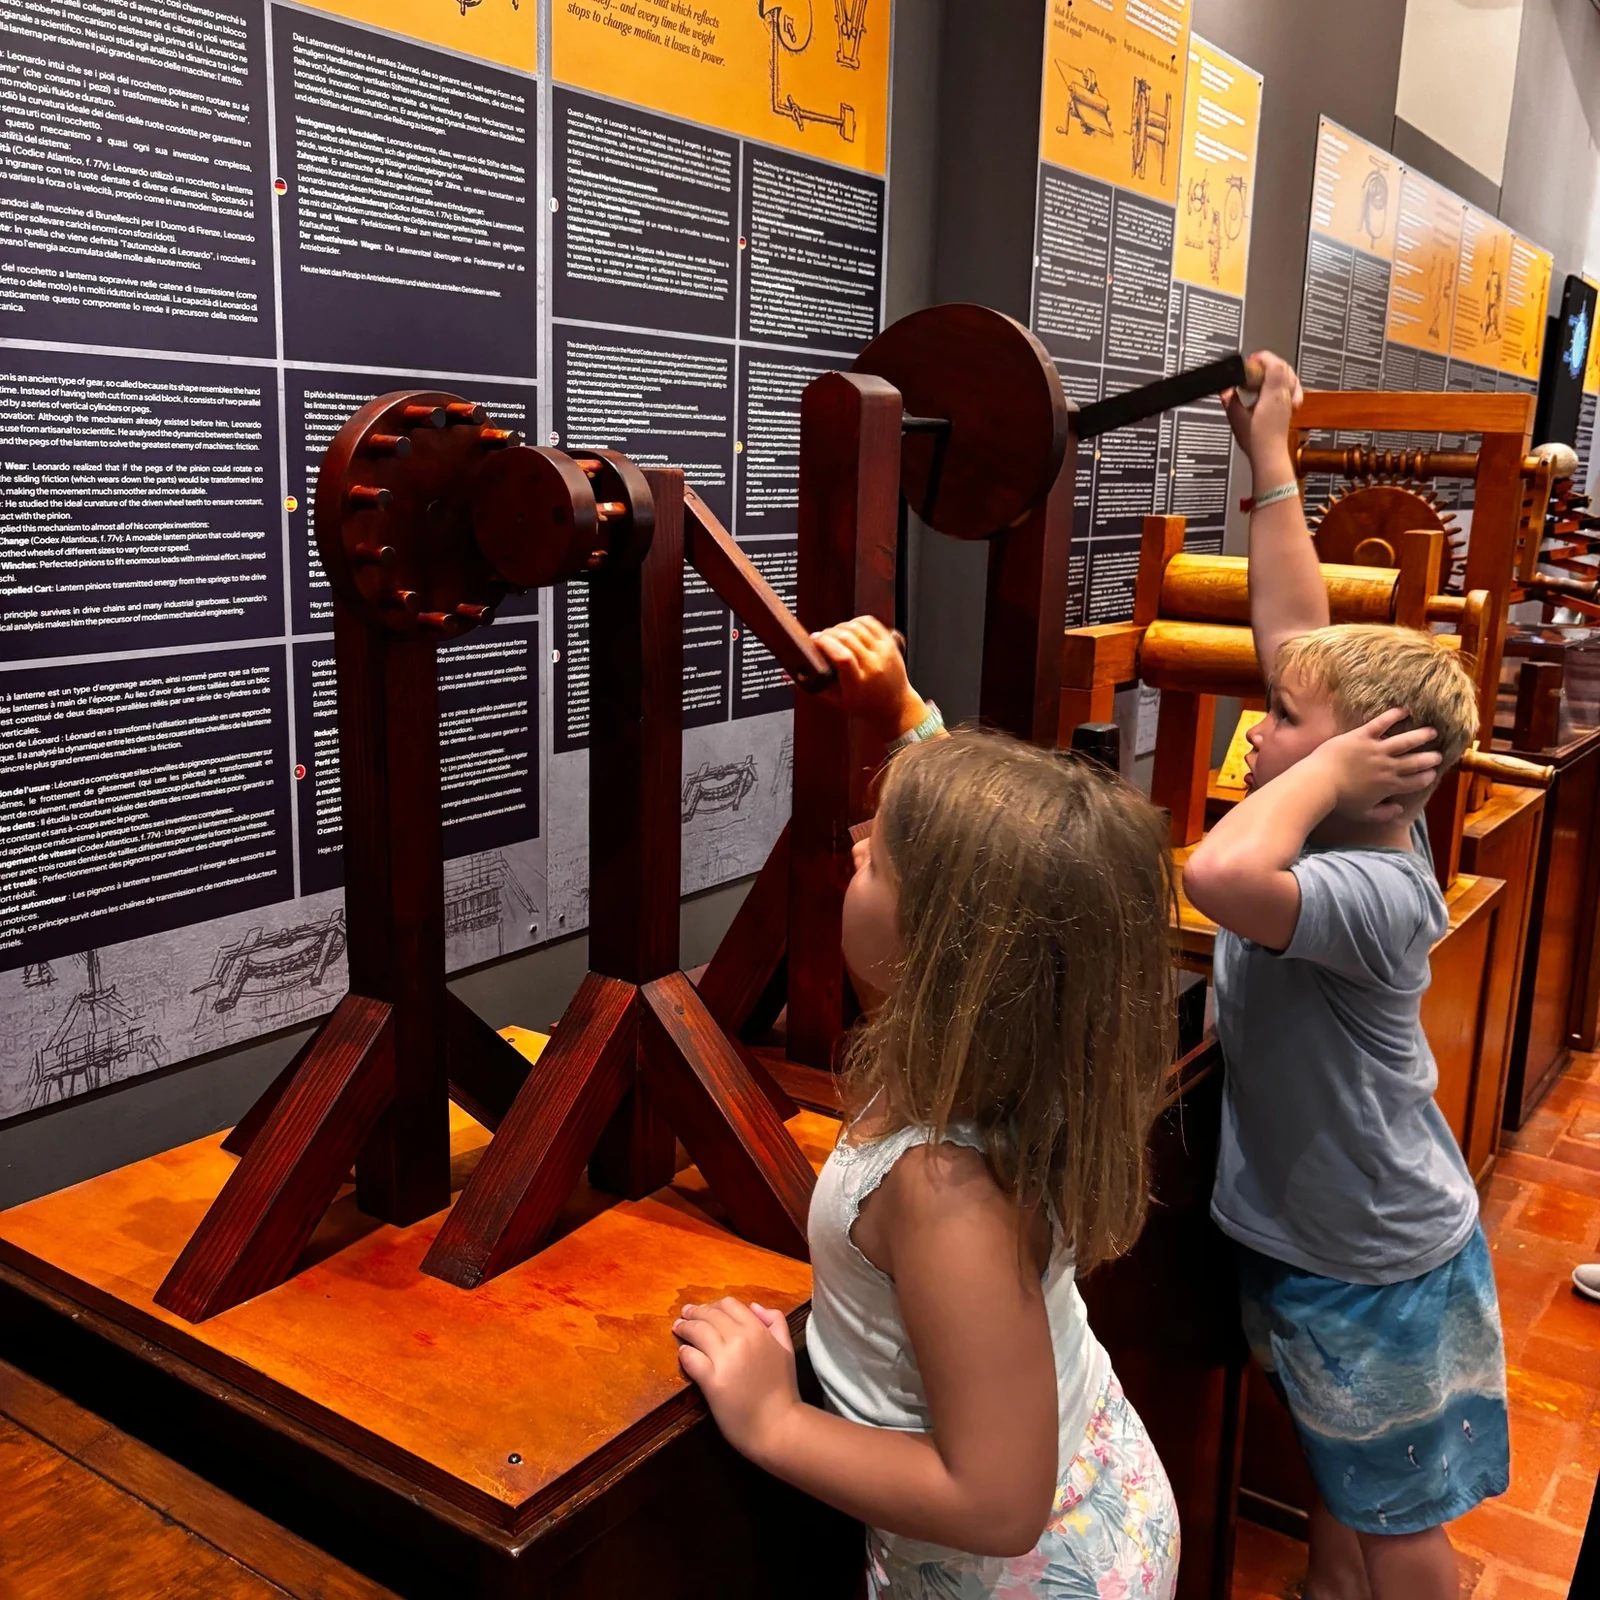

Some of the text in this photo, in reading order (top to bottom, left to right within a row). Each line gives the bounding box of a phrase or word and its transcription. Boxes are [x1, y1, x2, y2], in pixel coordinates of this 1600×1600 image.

[567, 2, 590, 21] stops
[593, 10, 600, 23] to
[603, 13, 632, 37] change
[664, 35, 670, 48] it
[671, 36, 690, 54] loses
[691, 44, 700, 58] its
[700, 51, 725, 67] power.
[620, 2, 638, 16] and
[638, 10, 660, 28] every
[661, 16, 678, 31] time
[679, 20, 691, 36] the
[692, 30, 716, 46] weight
[670, 0, 692, 19] which
[694, 9, 720, 29] reflects
[7, 50, 46, 66] Leonardo
[66, 64, 82, 74] che
[83, 69, 93, 77] se
[99, 72, 116, 81] pioli
[117, 75, 129, 84] del
[131, 79, 167, 93] rocchetto
[168, 88, 205, 102] potessero
[206, 96, 231, 108] ruotare
[242, 104, 250, 112] sé
[294, 68, 326, 84] Leonardos
[363, 86, 390, 100] Leonardo
[392, 95, 417, 107] wandelte
[419, 101, 428, 110] die
[430, 104, 462, 120] Verwendung
[464, 113, 480, 123] dieses
[482, 117, 514, 131] Mechanismus
[5, 119, 35, 130] questo
[41, 126, 91, 141] meccanismo
[108, 138, 128, 148] quasi
[133, 143, 150, 153] ogni
[155, 147, 168, 156] sua
[173, 149, 209, 164] invenzione
[30, 201, 44, 211] alle
[46, 205, 85, 217] macchine
[86, 210, 94, 218] di
[95, 210, 140, 225] Brunelleschi
[161, 220, 187, 232] Duomo
[224, 230, 255, 242] Leonardo
[38, 413, 74, 423] Although
[76, 414, 89, 423] the
[91, 416, 134, 424] mechanism
[136, 417, 162, 427] already
[164, 418, 189, 426] existed
[191, 419, 214, 427] before
[231, 421, 262, 429] Leonardo
[313, 402, 337, 410] linternas
[32, 462, 70, 471] Leonardo
[73, 463, 102, 471] realized
[190, 464, 211, 473] pinion
[4, 610, 38, 621] principle
[41, 608, 71, 617] survives
[82, 606, 101, 614] drive
[102, 604, 126, 613] chains
[128, 603, 142, 611] and
[164, 599, 194, 608] industrial
[6, 693, 12, 701] à
[14, 691, 46, 700] lanterne
[73, 686, 91, 695] type
[165, 675, 180, 684] ainsi
[182, 672, 207, 682] nommé
[208, 672, 227, 680] parce
[21, 895, 67, 910] automoteur
[73, 891, 85, 899] Les
[87, 885, 116, 897] pignons
[122, 877, 151, 888] lanterne
[151, 866, 199, 882] transmettaient
[240, 852, 265, 862] ressorts
